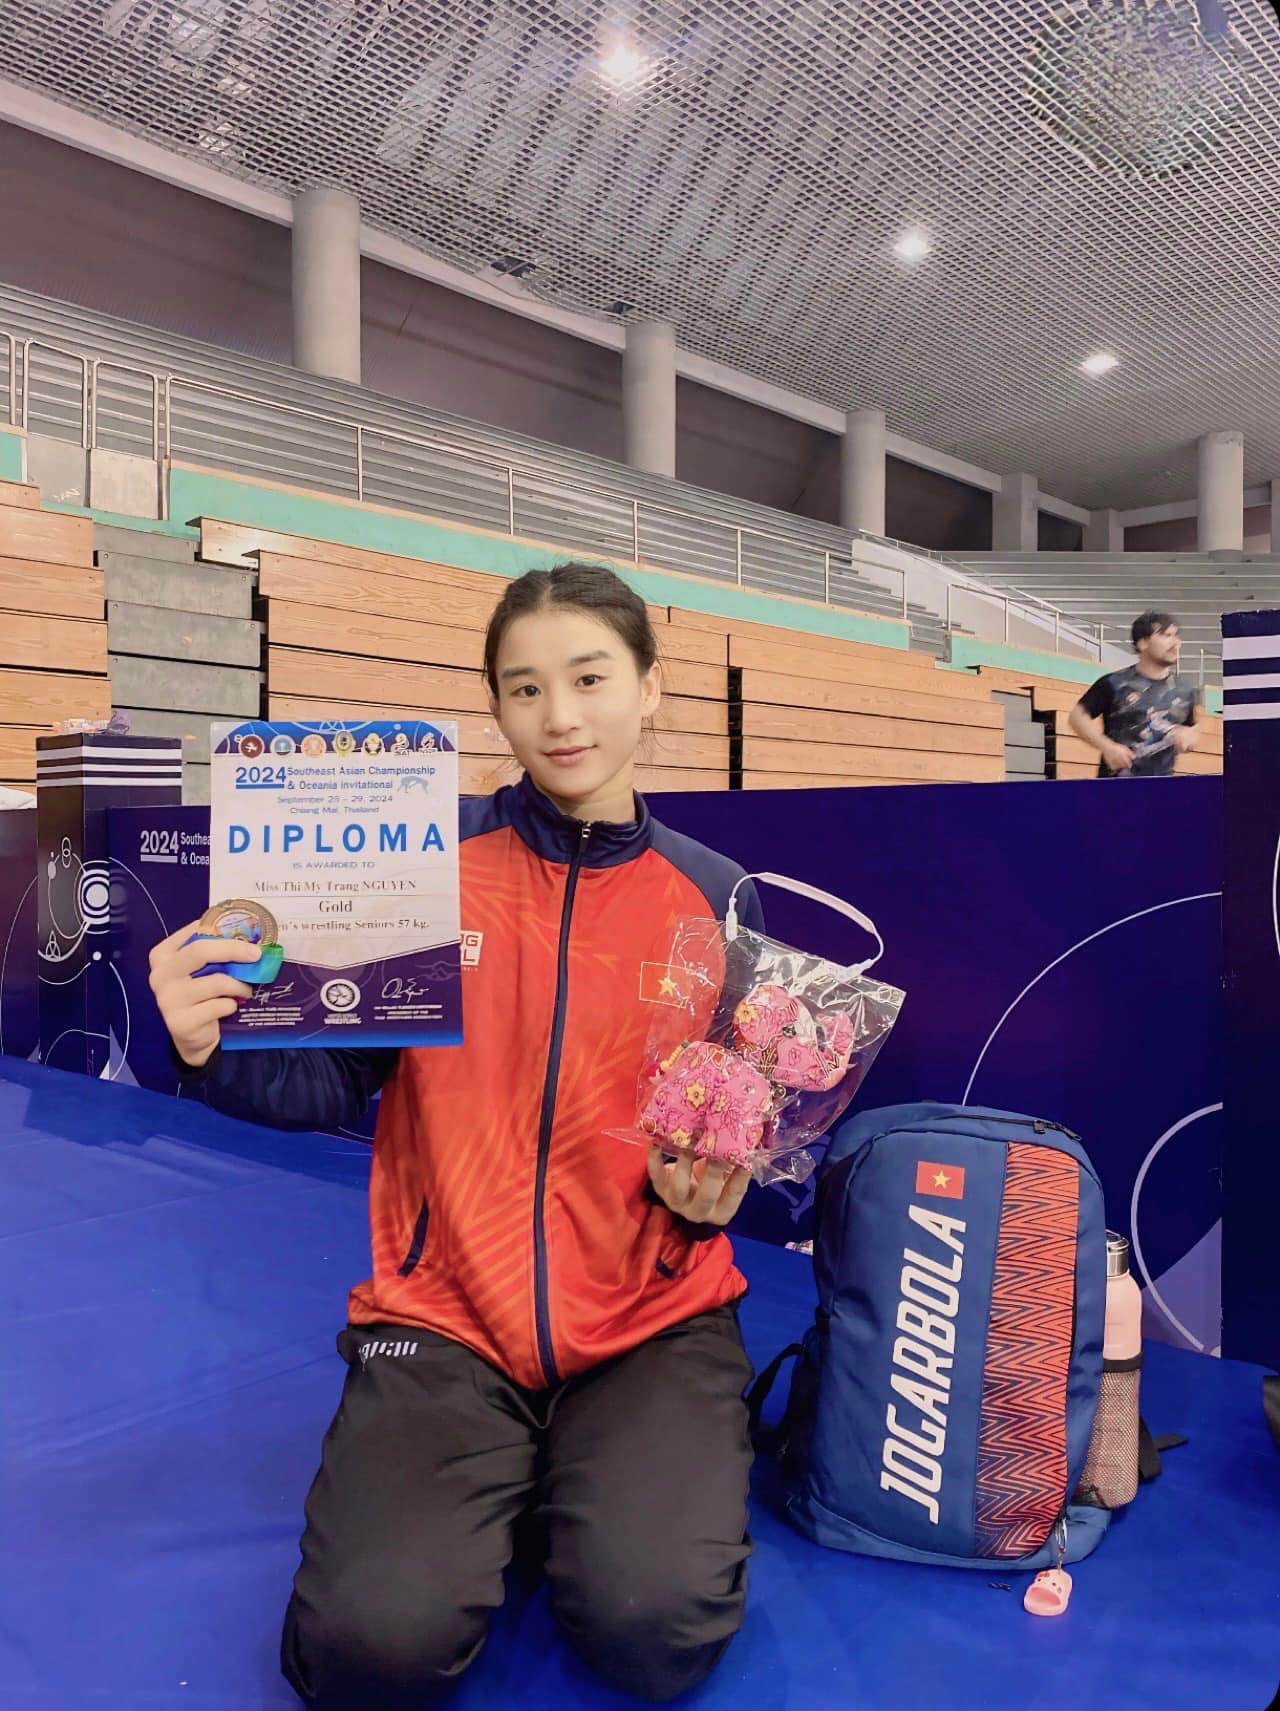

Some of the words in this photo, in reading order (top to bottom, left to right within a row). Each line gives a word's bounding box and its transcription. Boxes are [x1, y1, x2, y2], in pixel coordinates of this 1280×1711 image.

[235, 766, 287, 784] 2024
[287, 767, 336, 776] Southeast
[339, 766, 366, 776] Asian
[368, 766, 436, 777] Championship
[287, 781, 295, 790] &
[299, 780, 338, 790] Oceania
[369, 795, 393, 803] 2024
[140, 830, 180, 854] 2024
[180, 832, 211, 846] Southea
[228, 823, 445, 854] DIPLOMA
[180, 852, 188, 865] &
[190, 852, 210, 865] Ocea
[305, 861, 358, 870] AWARDED
[362, 861, 376, 869] TO
[255, 881, 279, 892] Miss
[283, 881, 300, 892] Thi
[301, 881, 321, 894] My
[327, 880, 359, 893] Trang
[362, 880, 416, 891] NGUYEN
[319, 900, 353, 913] Gold
[301, 920, 351, 932] wrestling
[354, 919, 395, 930] Seniors
[398, 919, 410, 929] 57
[412, 919, 430, 931] kg.
[880, 1203, 967, 1525] JOGARBOLA
